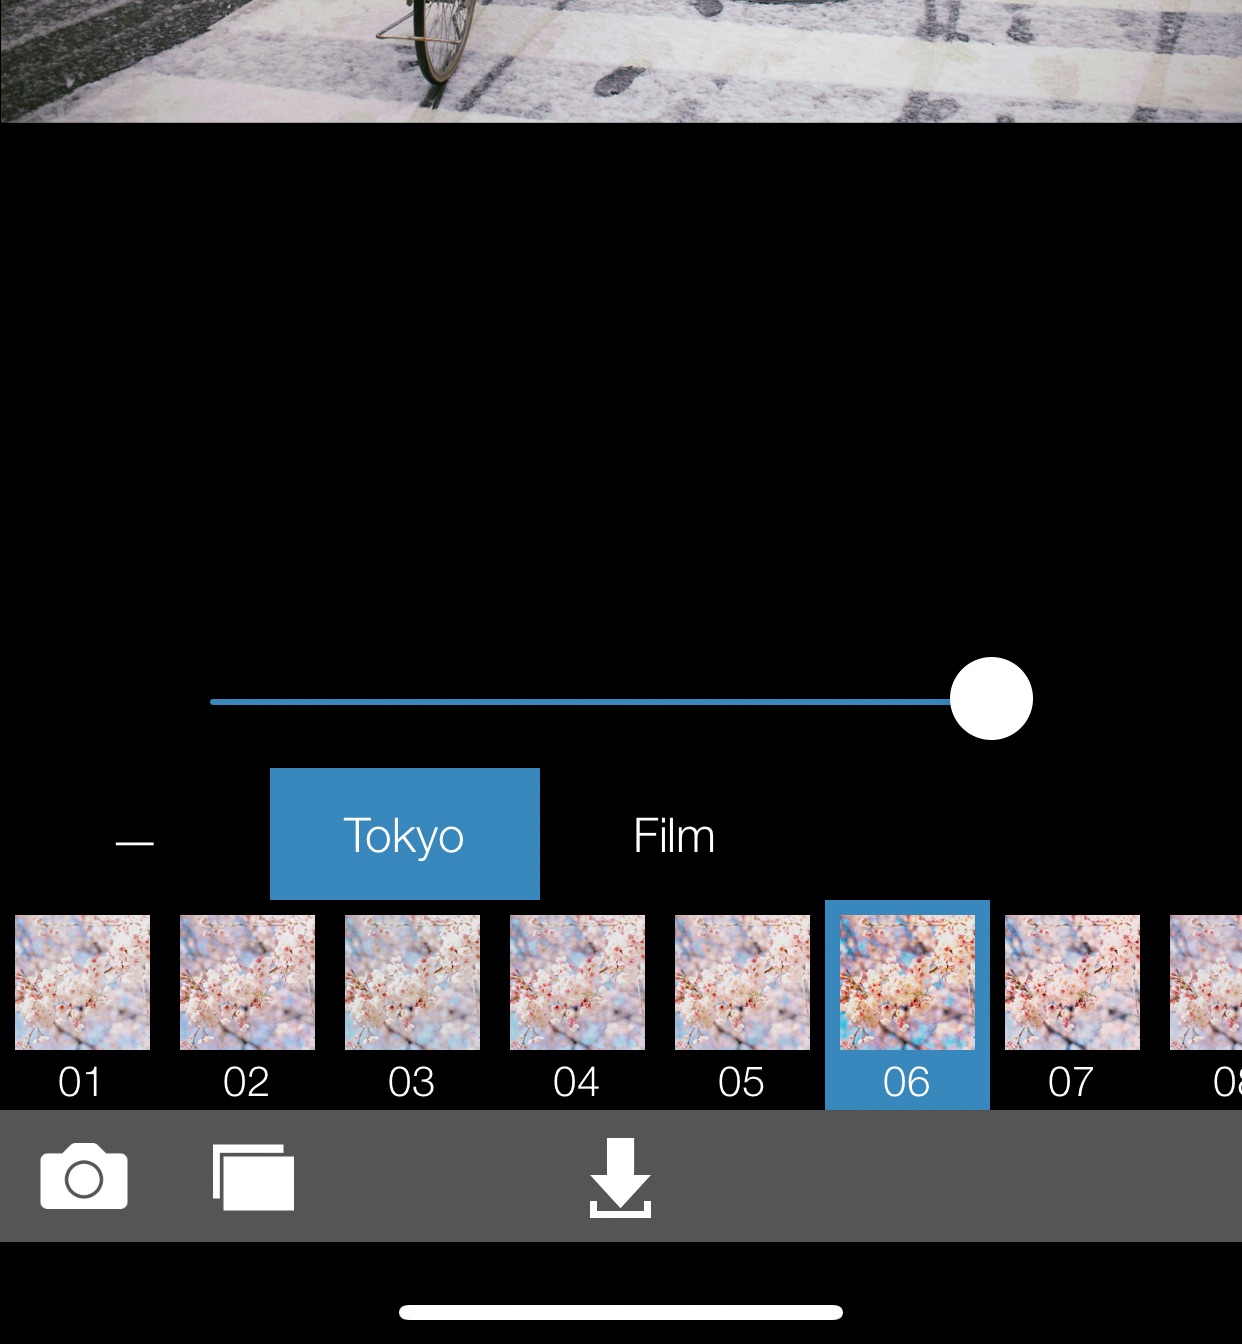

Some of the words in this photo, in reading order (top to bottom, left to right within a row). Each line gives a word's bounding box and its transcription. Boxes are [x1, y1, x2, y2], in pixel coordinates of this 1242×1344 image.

[343, 817, 465, 862] Tokyo
[634, 817, 715, 853] Film
[59, 1065, 98, 1098] 01
[224, 1065, 268, 1098] 02
[389, 1065, 433, 1098] 03
[554, 1065, 599, 1098] 04
[719, 1065, 763, 1098] 05
[884, 1065, 929, 1098] 06
[1049, 1065, 1094, 1098] 07
[1214, 1065, 1242, 1098] 0
